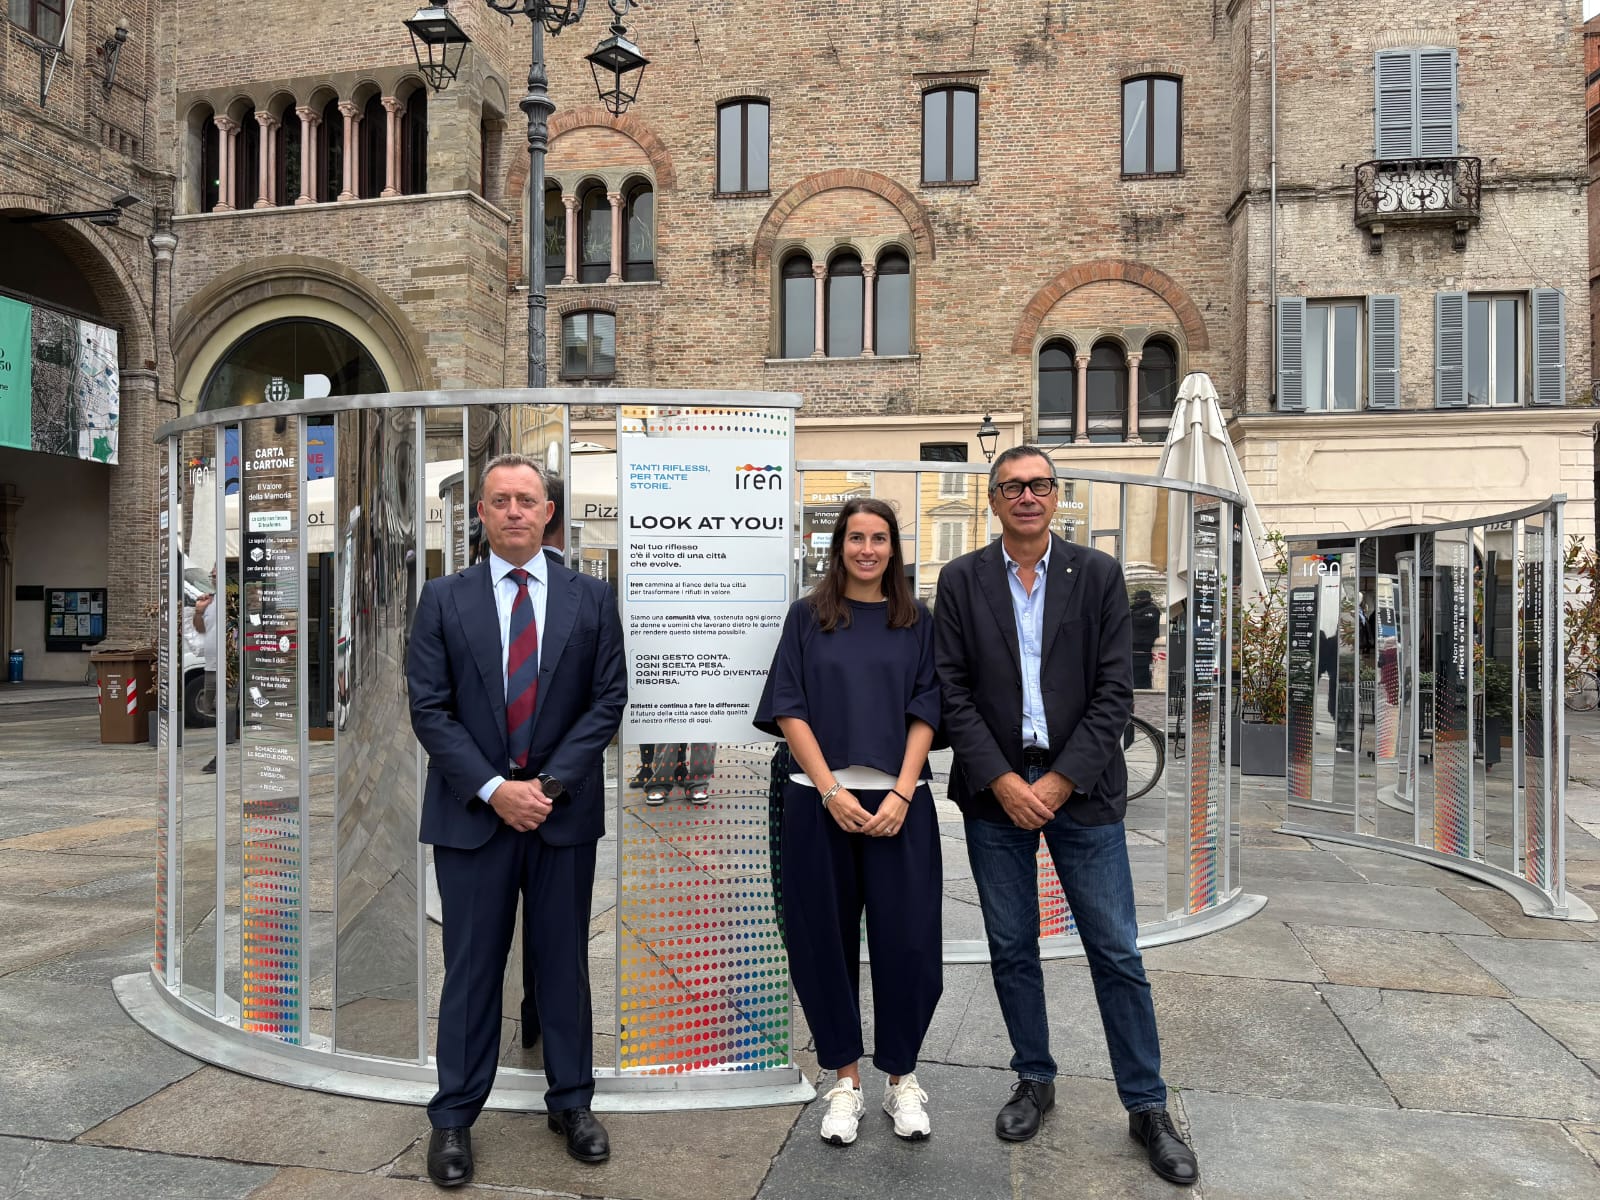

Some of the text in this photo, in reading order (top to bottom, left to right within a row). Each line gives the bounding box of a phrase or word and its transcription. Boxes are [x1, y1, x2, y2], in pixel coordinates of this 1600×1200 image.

[255, 447, 284, 458] CARTA
[245, 461, 251, 471] E
[253, 458, 295, 471] CARTONE
[630, 464, 711, 472] TANTI RIFLESSI,
[189, 466, 210, 486] iren
[262, 482, 282, 490] Valore
[630, 482, 672, 490] STORIE.
[736, 474, 782, 490] iren
[248, 492, 292, 500] della Memoria
[630, 516, 783, 530] LOOK AT YOU!
[1303, 562, 1341, 577] iren
[1458, 605, 1465, 616] la
[630, 614, 650, 622] Siamo
[652, 614, 664, 622] una
[665, 614, 696, 622] comunità
[713, 614, 744, 622] sostenuta
[745, 614, 759, 622] ogni
[760, 614, 782, 622] giorno
[1458, 635, 1465, 643] e
